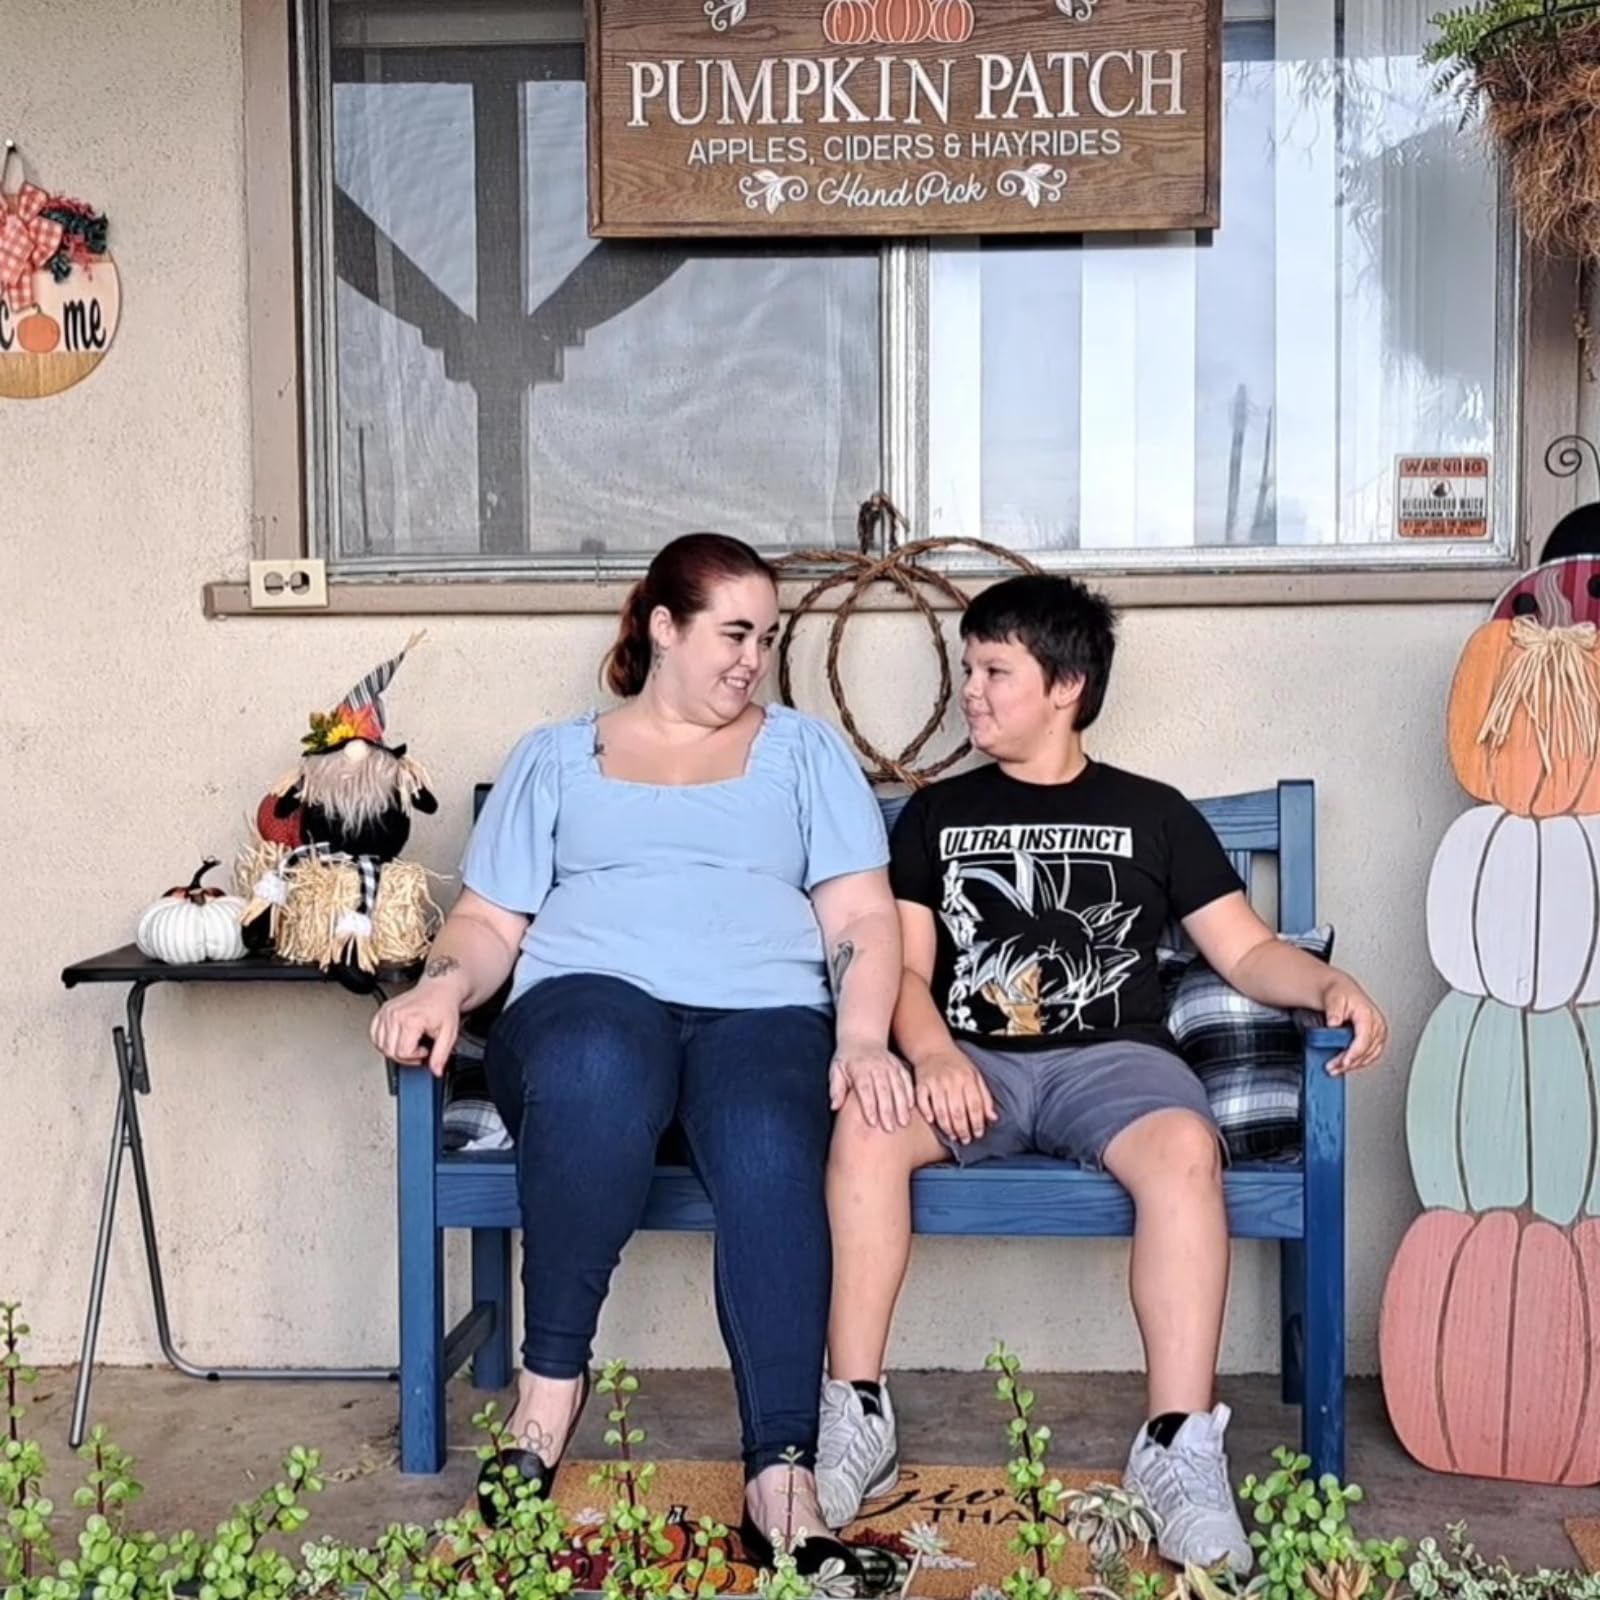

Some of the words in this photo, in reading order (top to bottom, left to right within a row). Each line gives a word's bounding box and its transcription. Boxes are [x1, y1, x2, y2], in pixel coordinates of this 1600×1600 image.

[625, 56, 958, 128] PUMPKIN
[976, 48, 1188, 121] PATCH
[687, 136, 817, 166] APPLES,
[823, 134, 935, 163] CIDERS
[944, 133, 962, 158] &
[971, 129, 1121, 159] HAYRIDES
[817, 172, 914, 208] Hand
[915, 170, 988, 207] Pick
[1404, 461, 1483, 473] WARNING
[945, 828, 1012, 856] ULTRA
[1018, 827, 1126, 852] INSTINCT
